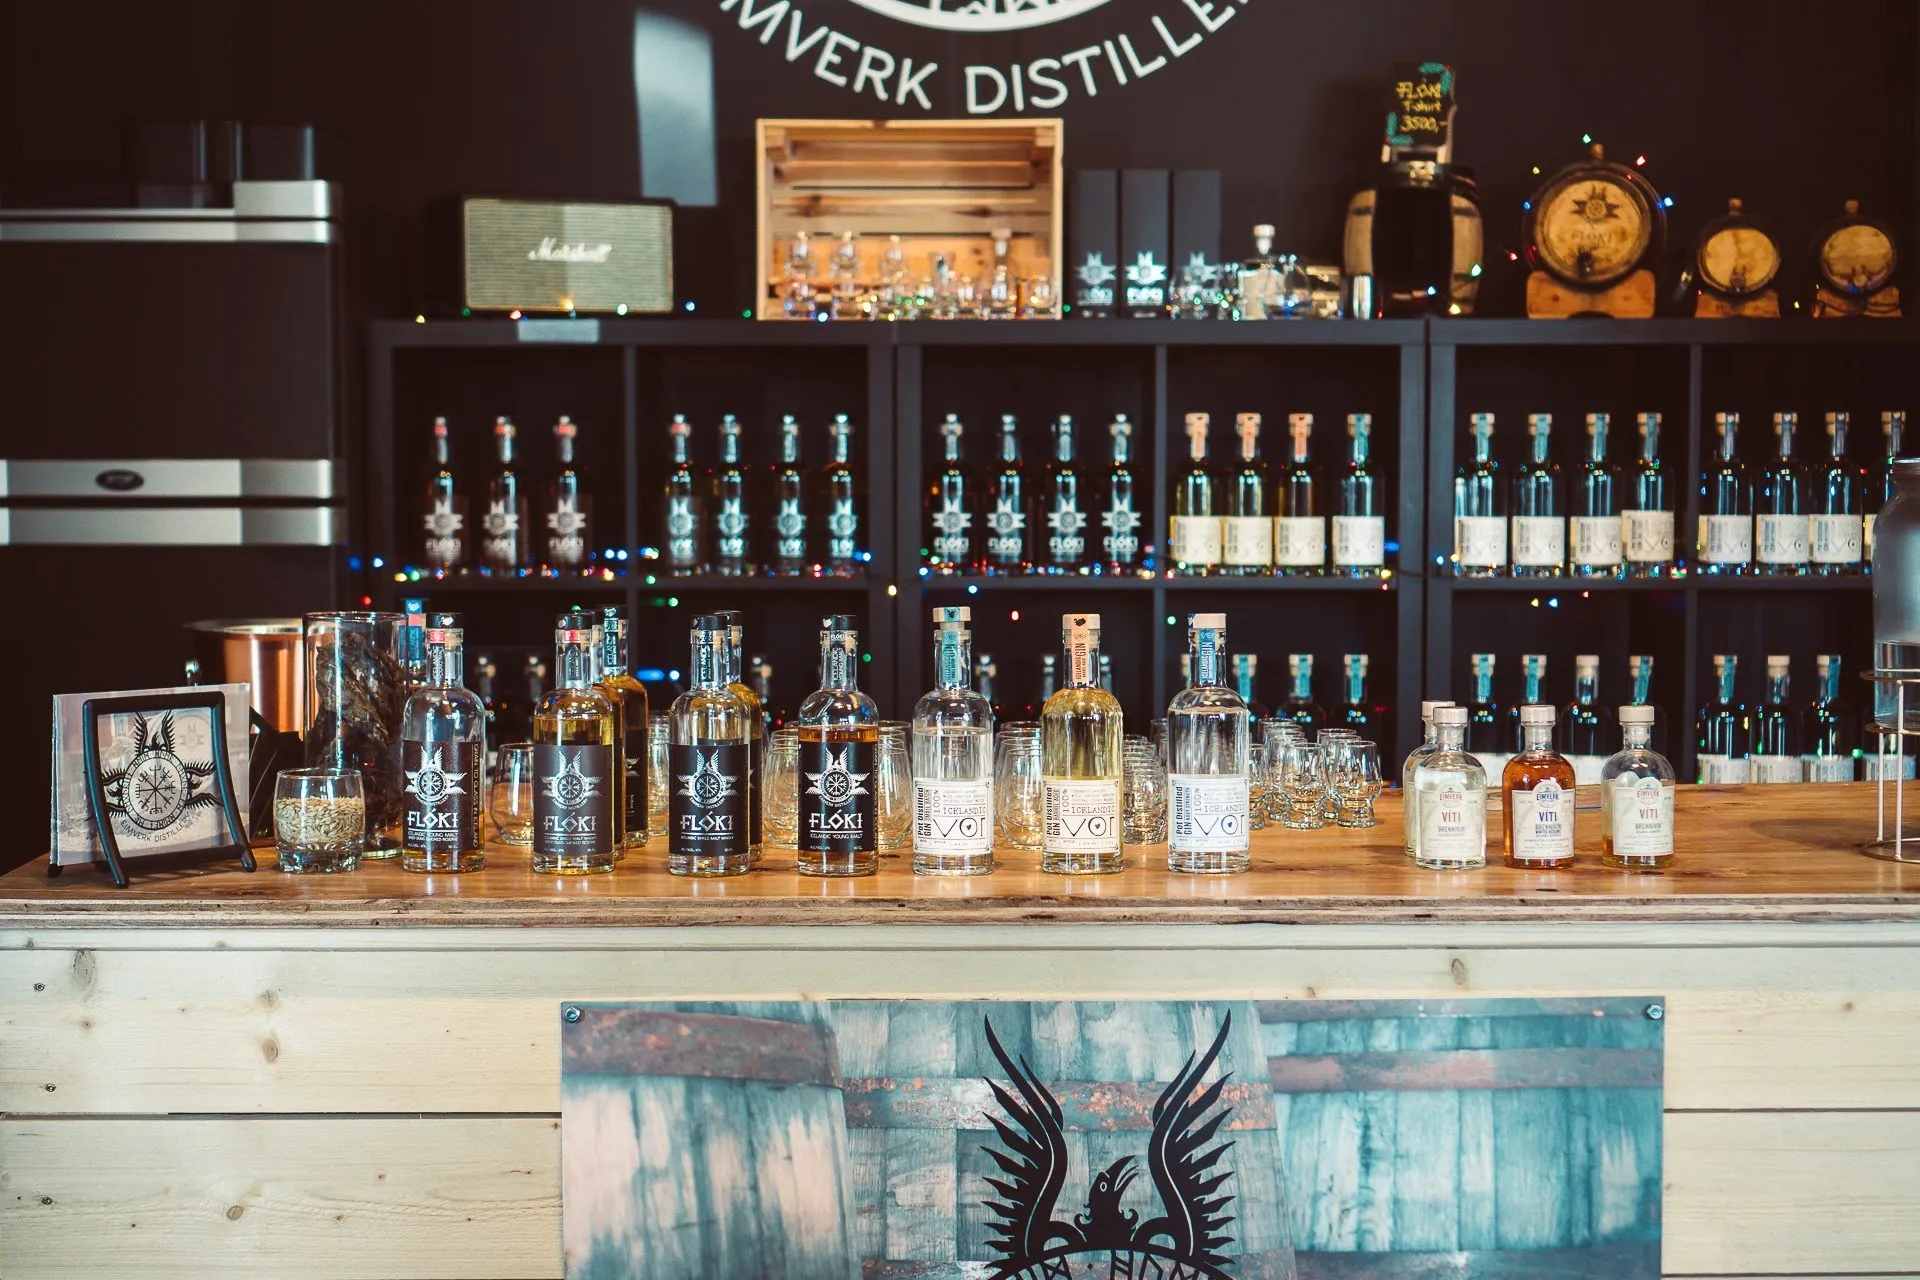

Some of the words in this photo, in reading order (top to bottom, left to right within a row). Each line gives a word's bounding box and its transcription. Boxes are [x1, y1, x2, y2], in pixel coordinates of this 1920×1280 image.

[964, 0, 1248, 114] DISTILLE
[1075, 643, 1086, 656] GIN
[1202, 642, 1213, 655] GIN
[1440, 793, 1463, 801] EIMVERK
[1536, 793, 1560, 801] EIMVERK
[1637, 790, 1659, 798] EIMVERK
[943, 806, 986, 815] ICELANDIC
[1071, 806, 1115, 814] ICELANDIC
[1204, 803, 1245, 813] ICELANDIC
[1639, 807, 1658, 819] VÍTI
[407, 808, 458, 828] FLÓKI
[543, 811, 597, 832] FLÓKI
[680, 811, 734, 832] FLÓKI
[808, 809, 862, 830] FLÓKI
[1441, 809, 1461, 823] VÍTI
[1538, 809, 1557, 822] VÍTI
[120, 819, 151, 842] EIMVERK
[154, 812, 190, 842] DISTILLERY
[923, 823, 932, 837] GIN
[1184, 821, 1192, 835] GIN
